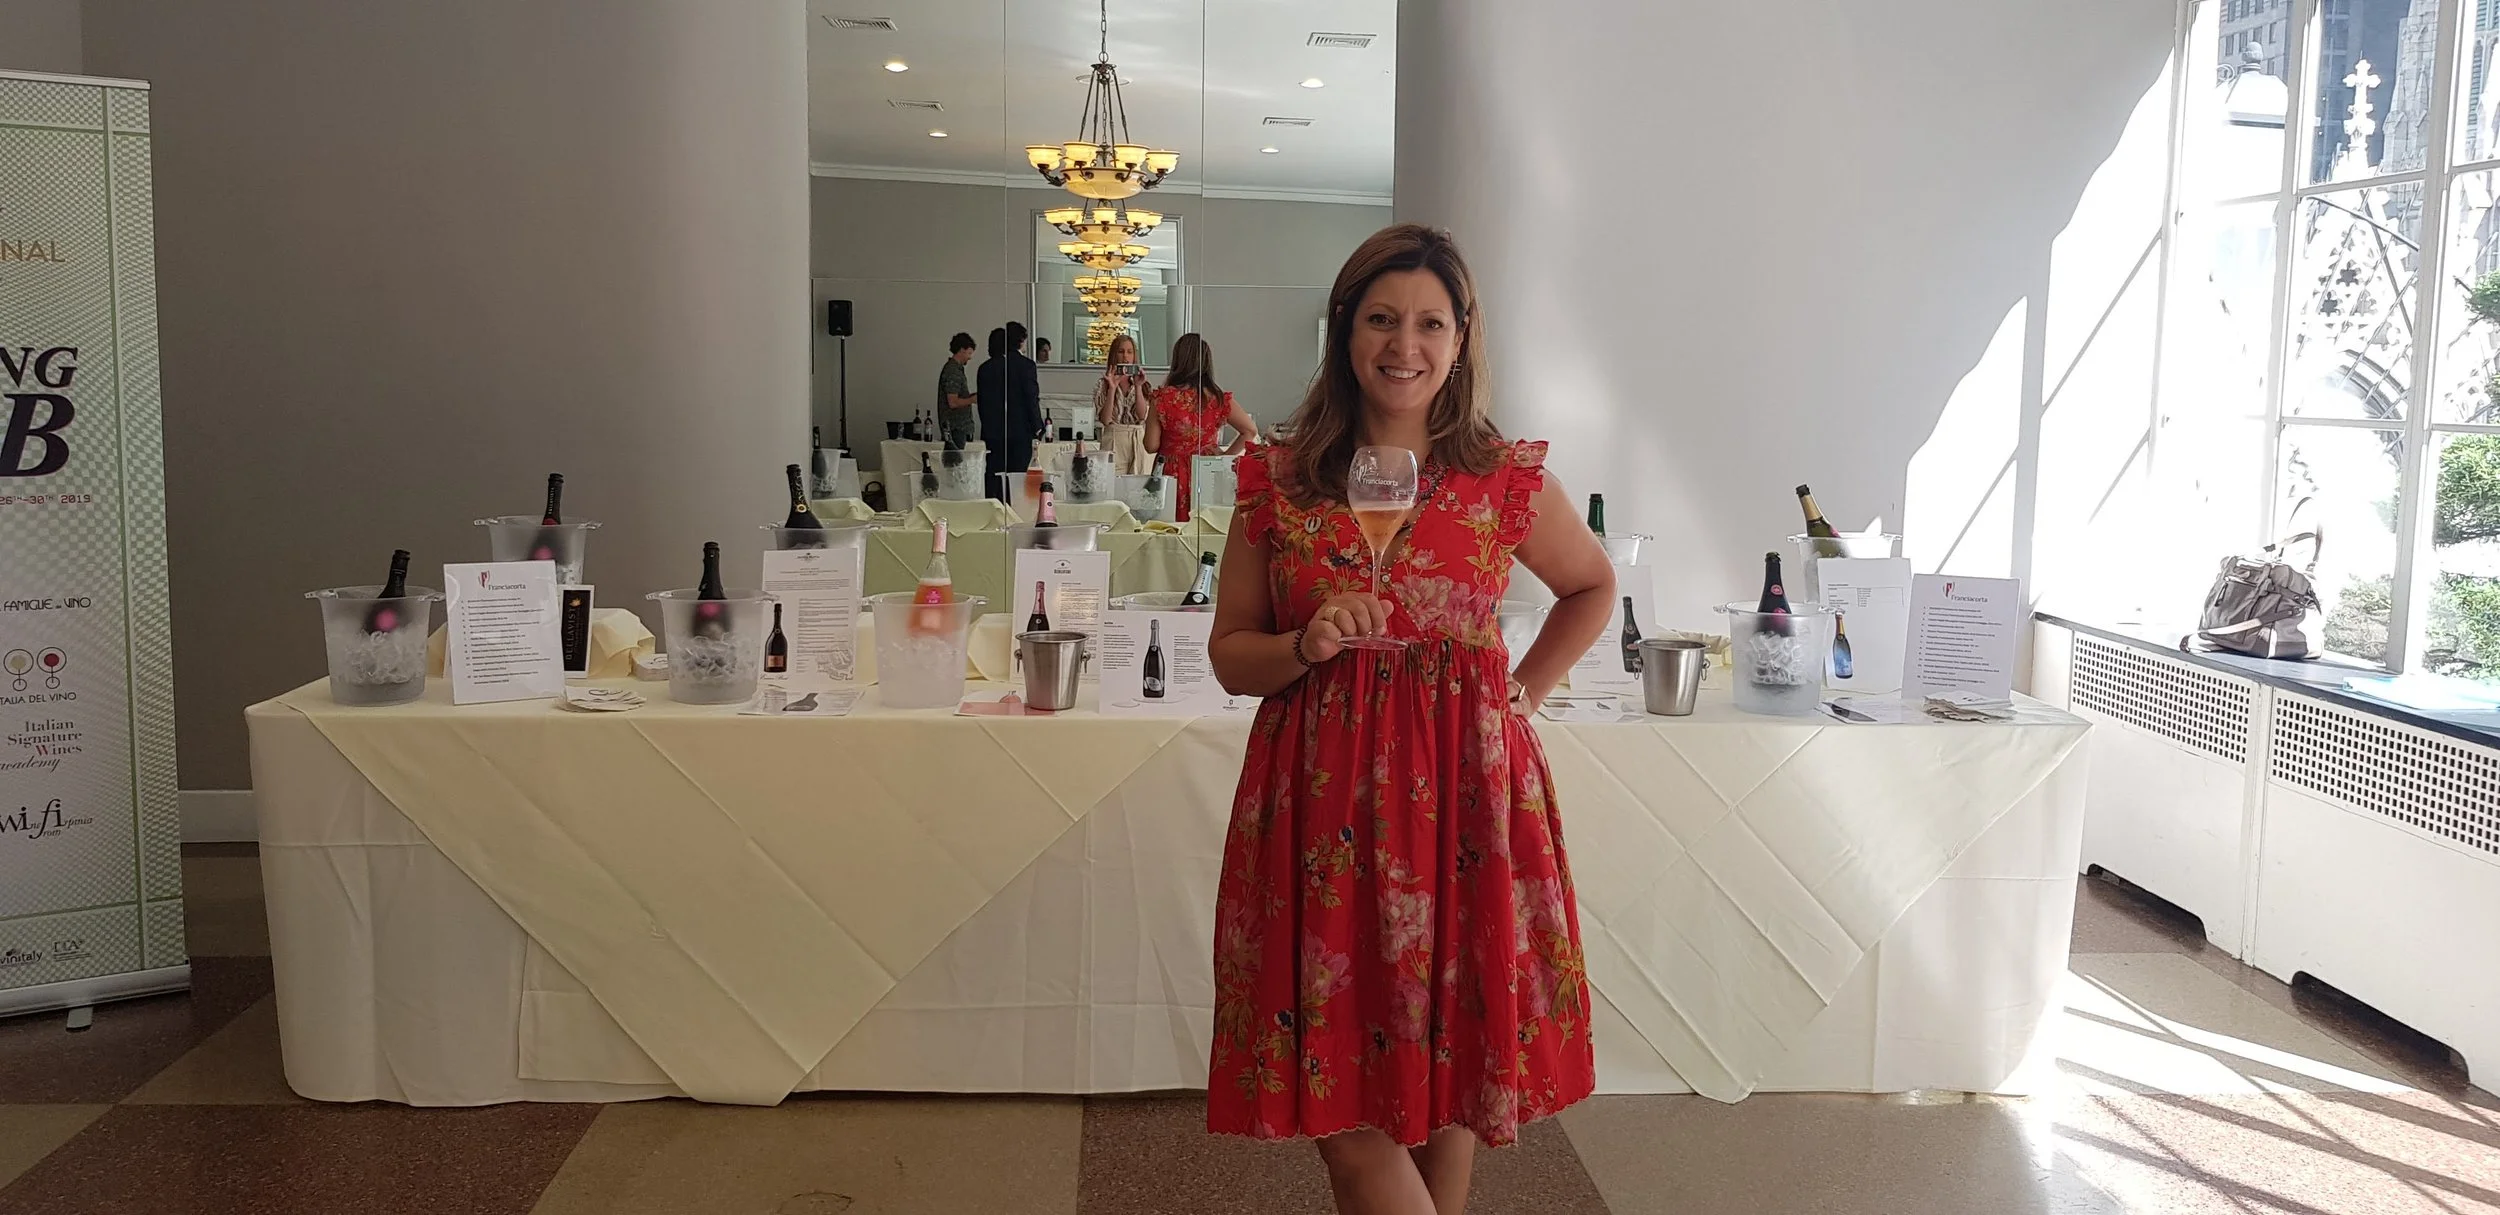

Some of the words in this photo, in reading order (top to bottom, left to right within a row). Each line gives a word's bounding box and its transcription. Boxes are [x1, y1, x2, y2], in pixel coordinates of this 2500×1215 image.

[0, 239, 66, 262] NAL
[0, 394, 75, 477] B
[60, 494, 92, 504] 2019
[488, 583, 526, 591] Franciacorta
[63, 597, 92, 608] VINO
[1950, 595, 1988, 603] Franciacorta
[28, 694, 46, 703] DEL
[49, 692, 77, 701] VINO
[25, 719, 75, 732] Italian
[7, 733, 82, 749] Signature
[35, 744, 82, 756] Wines
[0, 950, 43, 964] vinitaly
